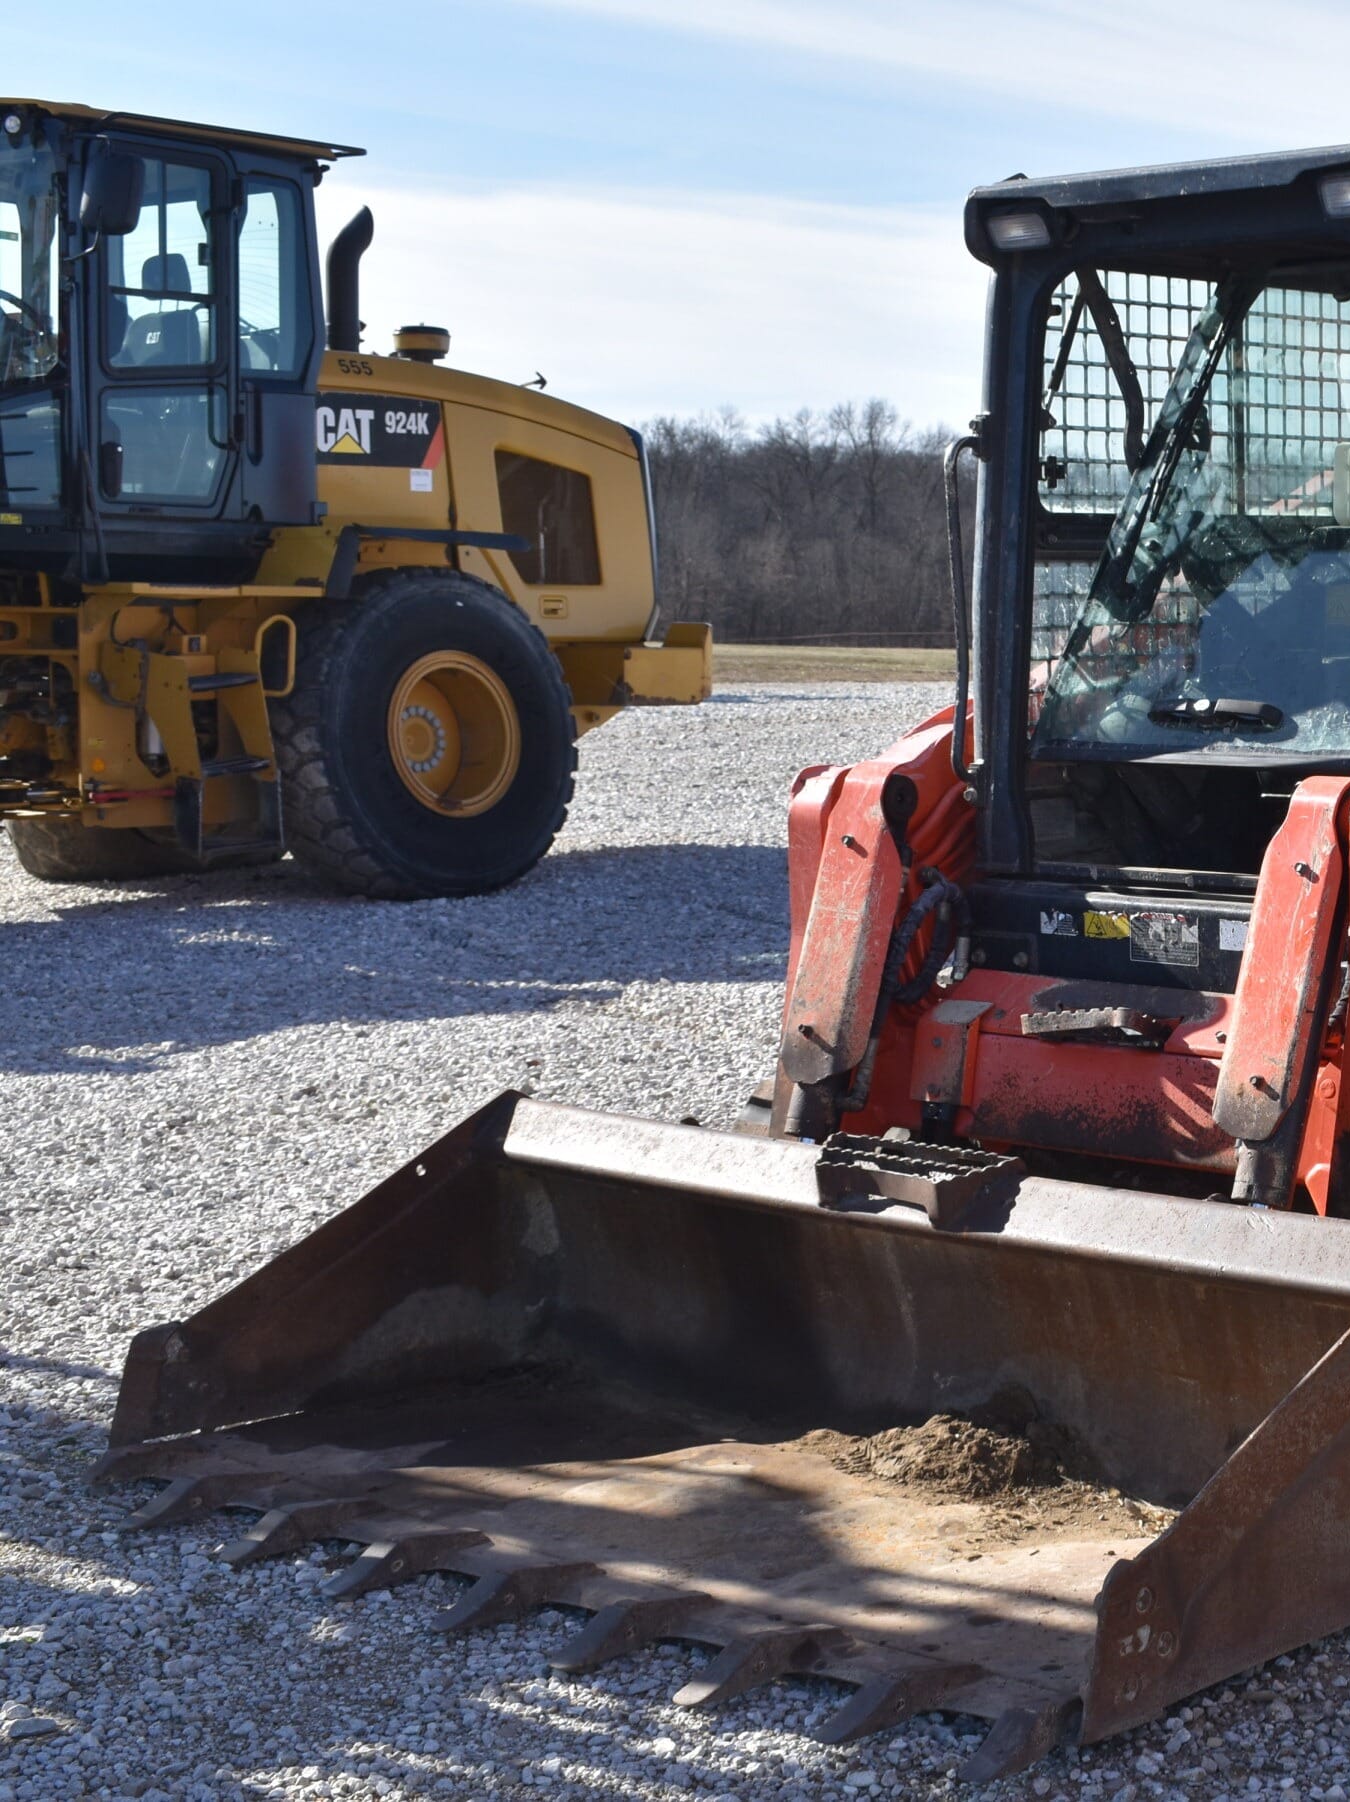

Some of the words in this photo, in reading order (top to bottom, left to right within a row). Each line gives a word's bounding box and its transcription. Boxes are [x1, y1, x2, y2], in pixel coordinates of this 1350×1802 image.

[338, 359, 373, 376] 555
[316, 406, 375, 455] CAT
[384, 410, 430, 435] 924K
